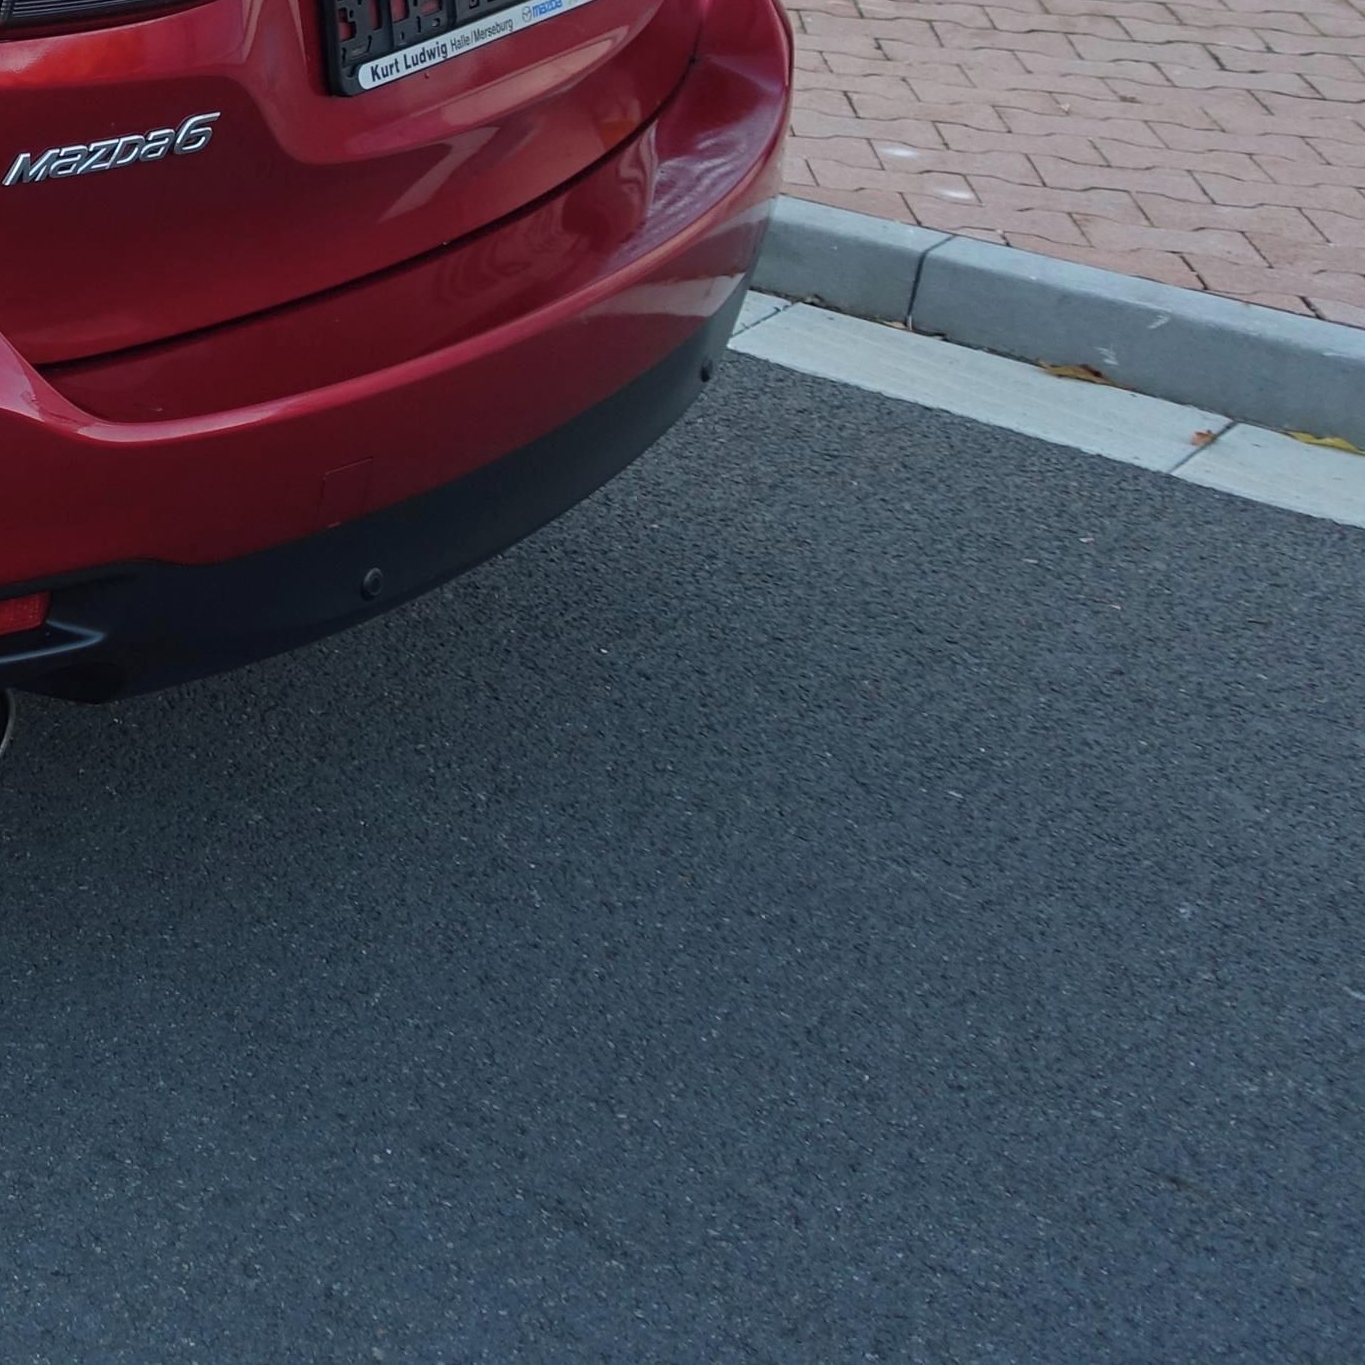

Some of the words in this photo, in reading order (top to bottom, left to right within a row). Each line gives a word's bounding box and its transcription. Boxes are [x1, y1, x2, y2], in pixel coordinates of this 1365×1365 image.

[371, 58, 401, 82] Kurt
[404, 42, 448, 70] Ludwig
[450, 17, 514, 52] Halle/Merseburg
